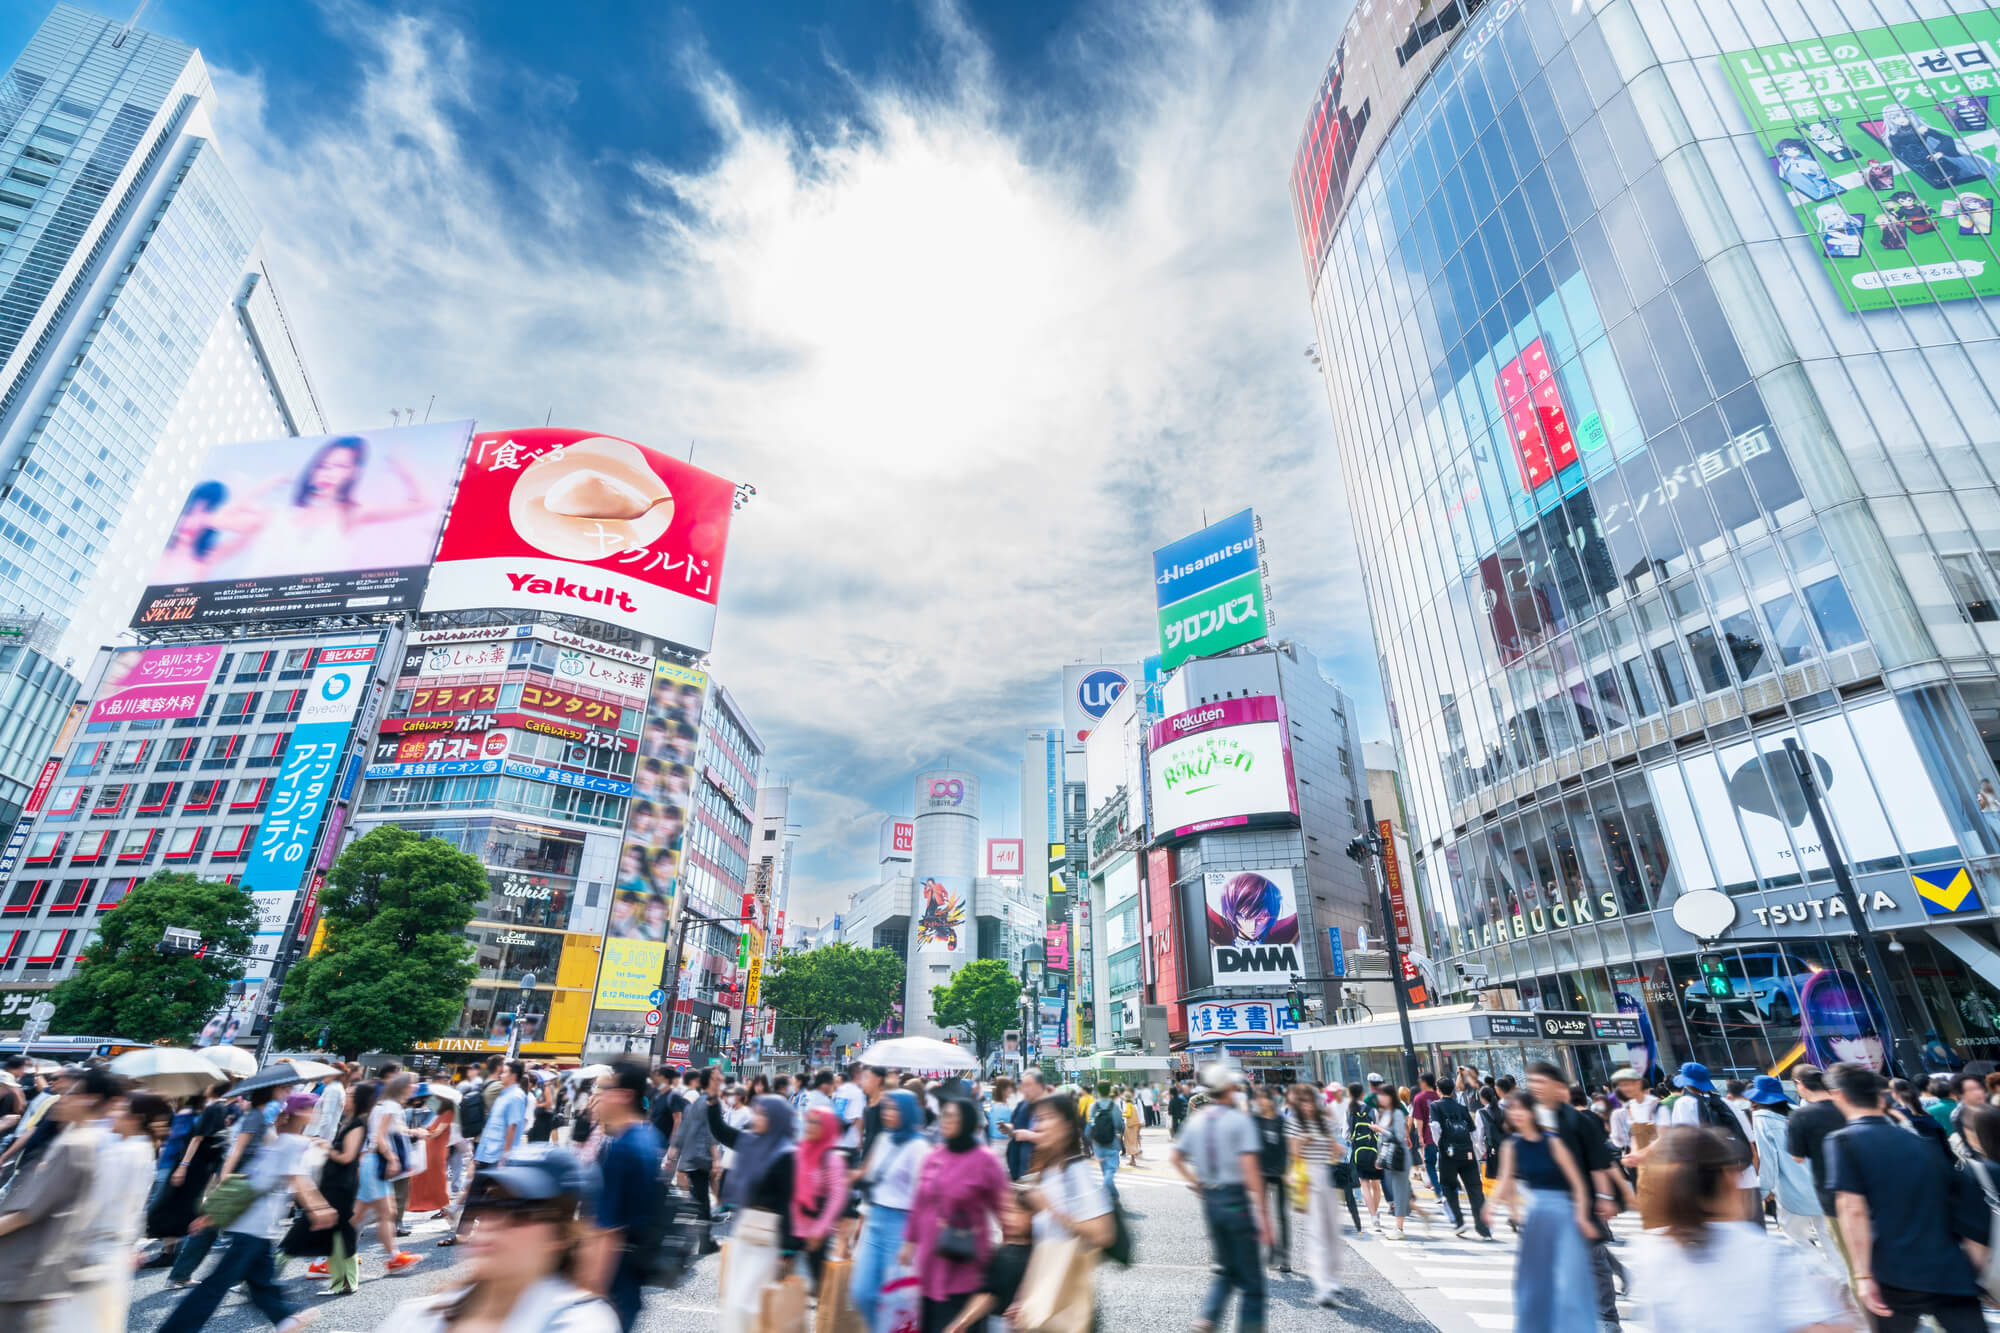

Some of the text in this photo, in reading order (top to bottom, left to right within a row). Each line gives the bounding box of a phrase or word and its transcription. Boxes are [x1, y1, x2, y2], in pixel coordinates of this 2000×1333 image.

[1740, 45, 1860, 74] LINEの
[476, 439, 566, 472] 「食べる
[1156, 537, 1253, 585] Hisamitsu
[506, 572, 638, 613] Yakult
[1164, 593, 1258, 649] サロンパス
[420, 627, 509, 642] しゃぶしゃぶバイキング
[159, 652, 214, 667] 品川スキン
[325, 648, 370, 662] 当ビル5F
[406, 656, 423, 667] 9F
[454, 647, 505, 666] しゃぶ葉
[154, 665, 204, 679] クリニック
[589, 661, 647, 689] しゃぶ葉
[106, 695, 196, 716] 品川美容外科
[415, 688, 497, 708] プライス
[522, 686, 618, 722] コンタクト
[455, 714, 498, 732] ガスト
[1172, 707, 1225, 732] Rakuten
[377, 743, 399, 758] 7F
[402, 742, 425, 753] Café
[424, 738, 479, 760] ガスト
[583, 730, 629, 752] ガスト
[402, 762, 480, 776] 英会話イーオン
[508, 763, 631, 794] AEON 英会話イーオン
[261, 743, 317, 863] アイシティ
[284, 743, 337, 863] コンタクトの
[927, 778, 964, 806] 109
[896, 838, 912, 849] QL
[1777, 843, 1823, 860] TSTAY
[1391, 894, 1409, 938] 三千里
[1752, 890, 1897, 926] TSUTAYA
[1457, 892, 1619, 952] STARBUCKS
[1216, 946, 1300, 973] DMM
[711, 1009, 728, 1027] LUSH
[1191, 1005, 1299, 1033] 大盛堂書店
